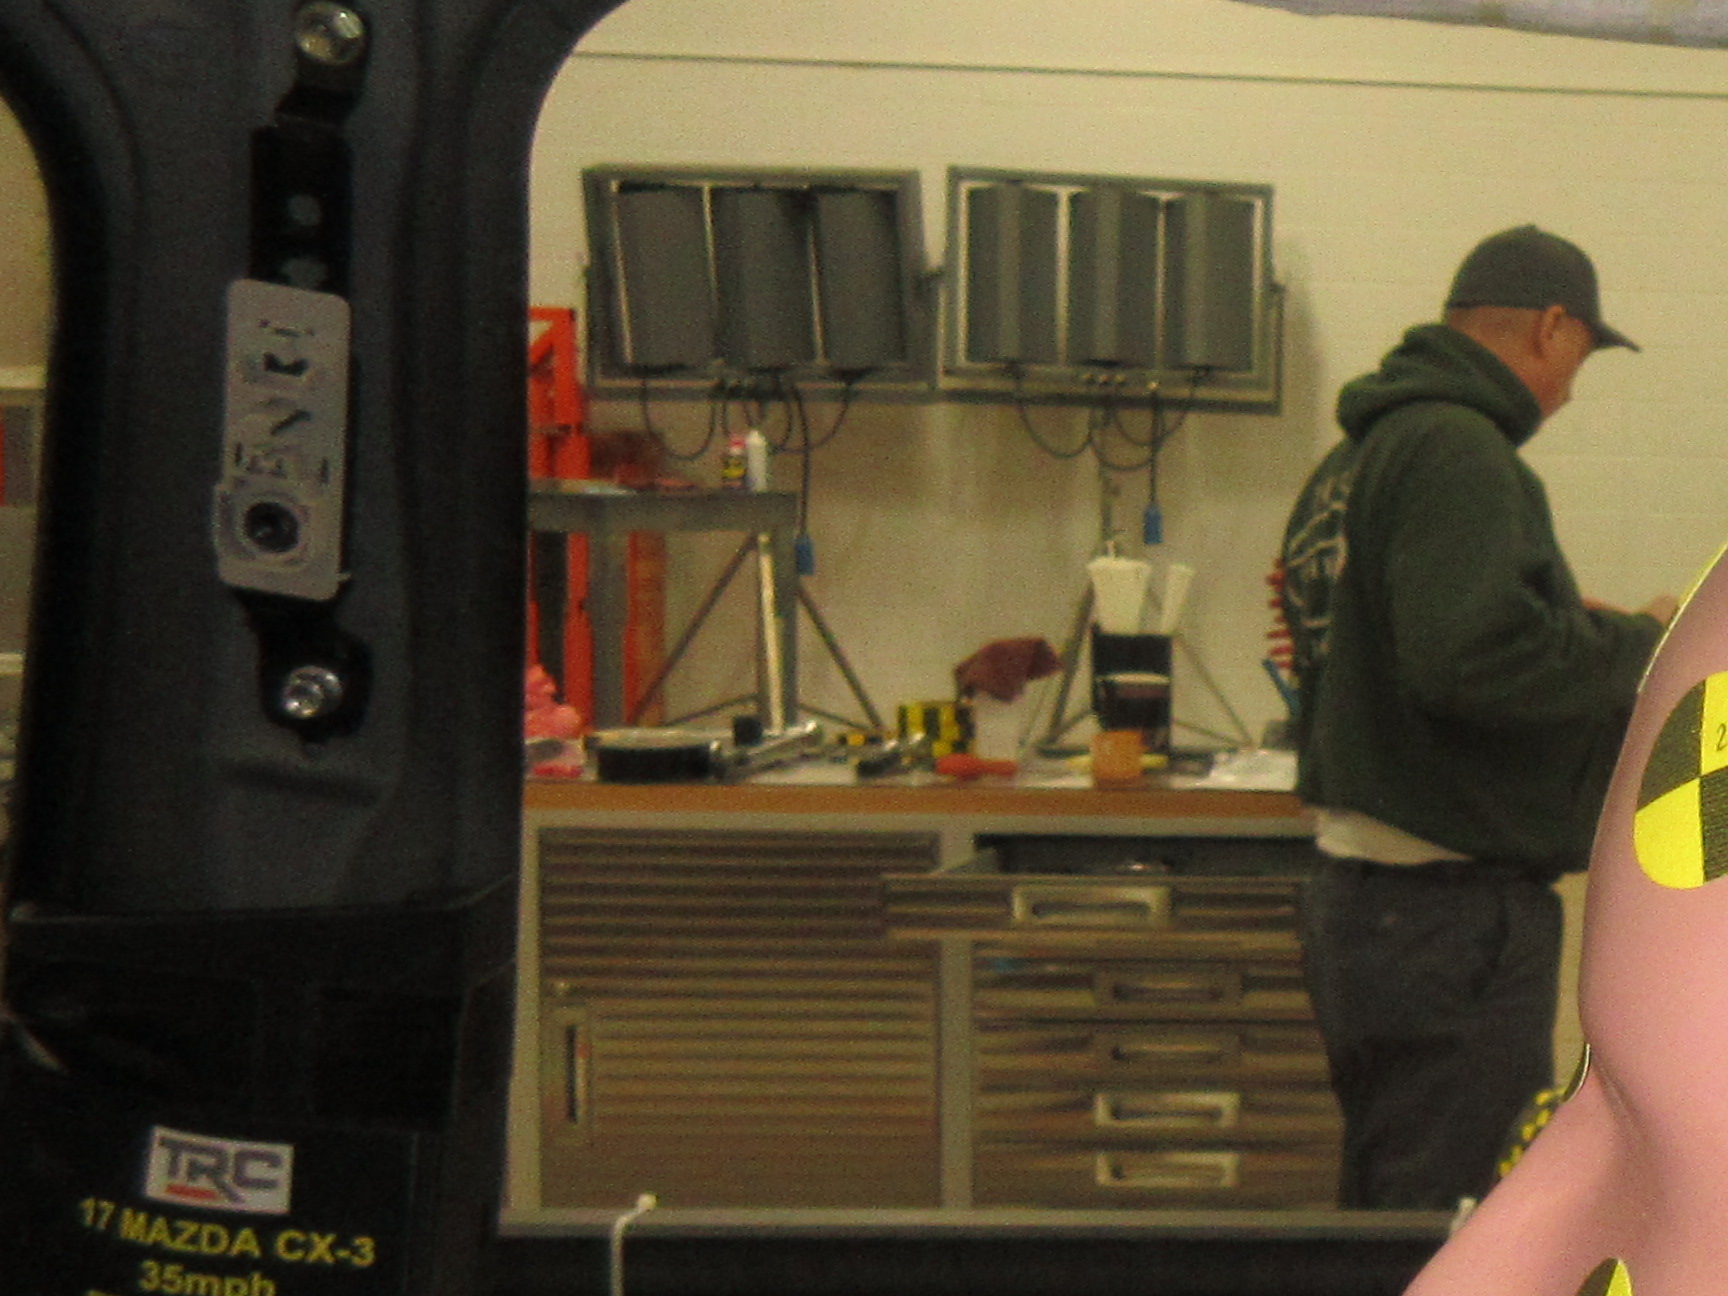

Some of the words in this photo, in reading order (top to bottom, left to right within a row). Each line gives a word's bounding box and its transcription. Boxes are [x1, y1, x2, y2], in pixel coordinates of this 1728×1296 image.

[160, 1136, 283, 1203] TRC
[80, 1197, 115, 1230] 17
[121, 1208, 260, 1257] MAZDA
[275, 1229, 376, 1268] CX-3
